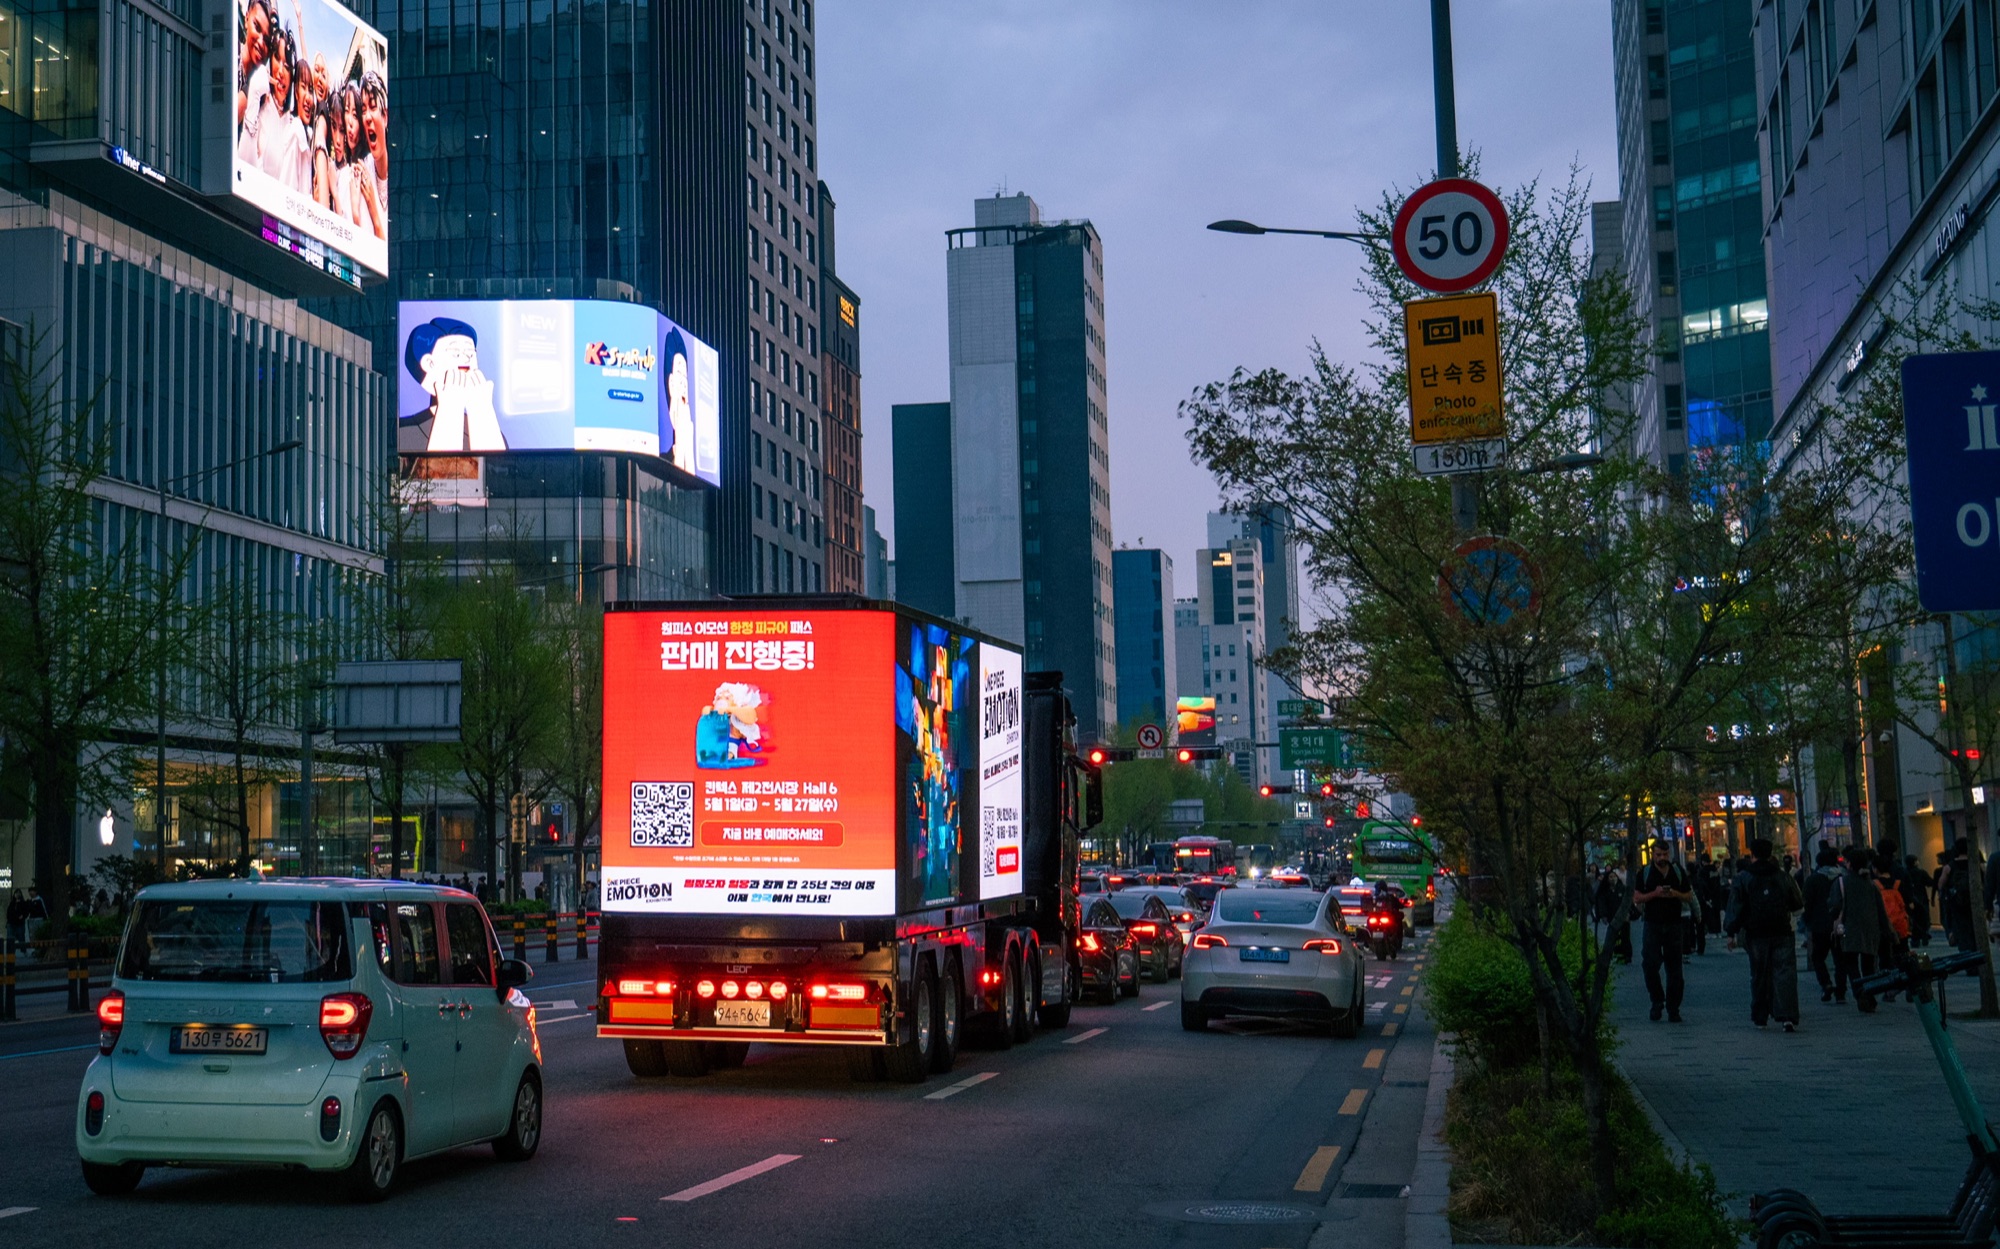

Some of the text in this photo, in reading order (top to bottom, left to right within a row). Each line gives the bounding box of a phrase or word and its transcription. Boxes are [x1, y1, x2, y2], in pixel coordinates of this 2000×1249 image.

[123, 150, 140, 172] liner
[1418, 211, 1483, 260] 50
[521, 314, 556, 331] NEW
[1420, 360, 1487, 388] 단속중
[1434, 395, 1477, 410] Photo
[1430, 447, 1488, 468] 150m
[661, 621, 812, 635] 원피스 이모션 한정 피규어 패스
[661, 640, 815, 670] 판매 진행중!
[984, 687, 1019, 739] EMOTION
[705, 781, 838, 795] 킨텍스 제2전시장 Hall 6
[705, 798, 723, 811] 5월
[725, 797, 758, 812] 1일(금)
[774, 798, 793, 812] 5월
[794, 798, 838, 812] 27일(수)
[722, 827, 823, 841] 지금 바로 예매하세요!
[607, 877, 640, 886] ONE PIECE
[762, 880, 784, 889] 함께
[786, 880, 798, 889] 한
[801, 880, 827, 890] 25년
[830, 880, 851, 890] 간의
[606, 883, 672, 901] EMOTION
[727, 893, 831, 903] 이제 한국에서 만나요!
